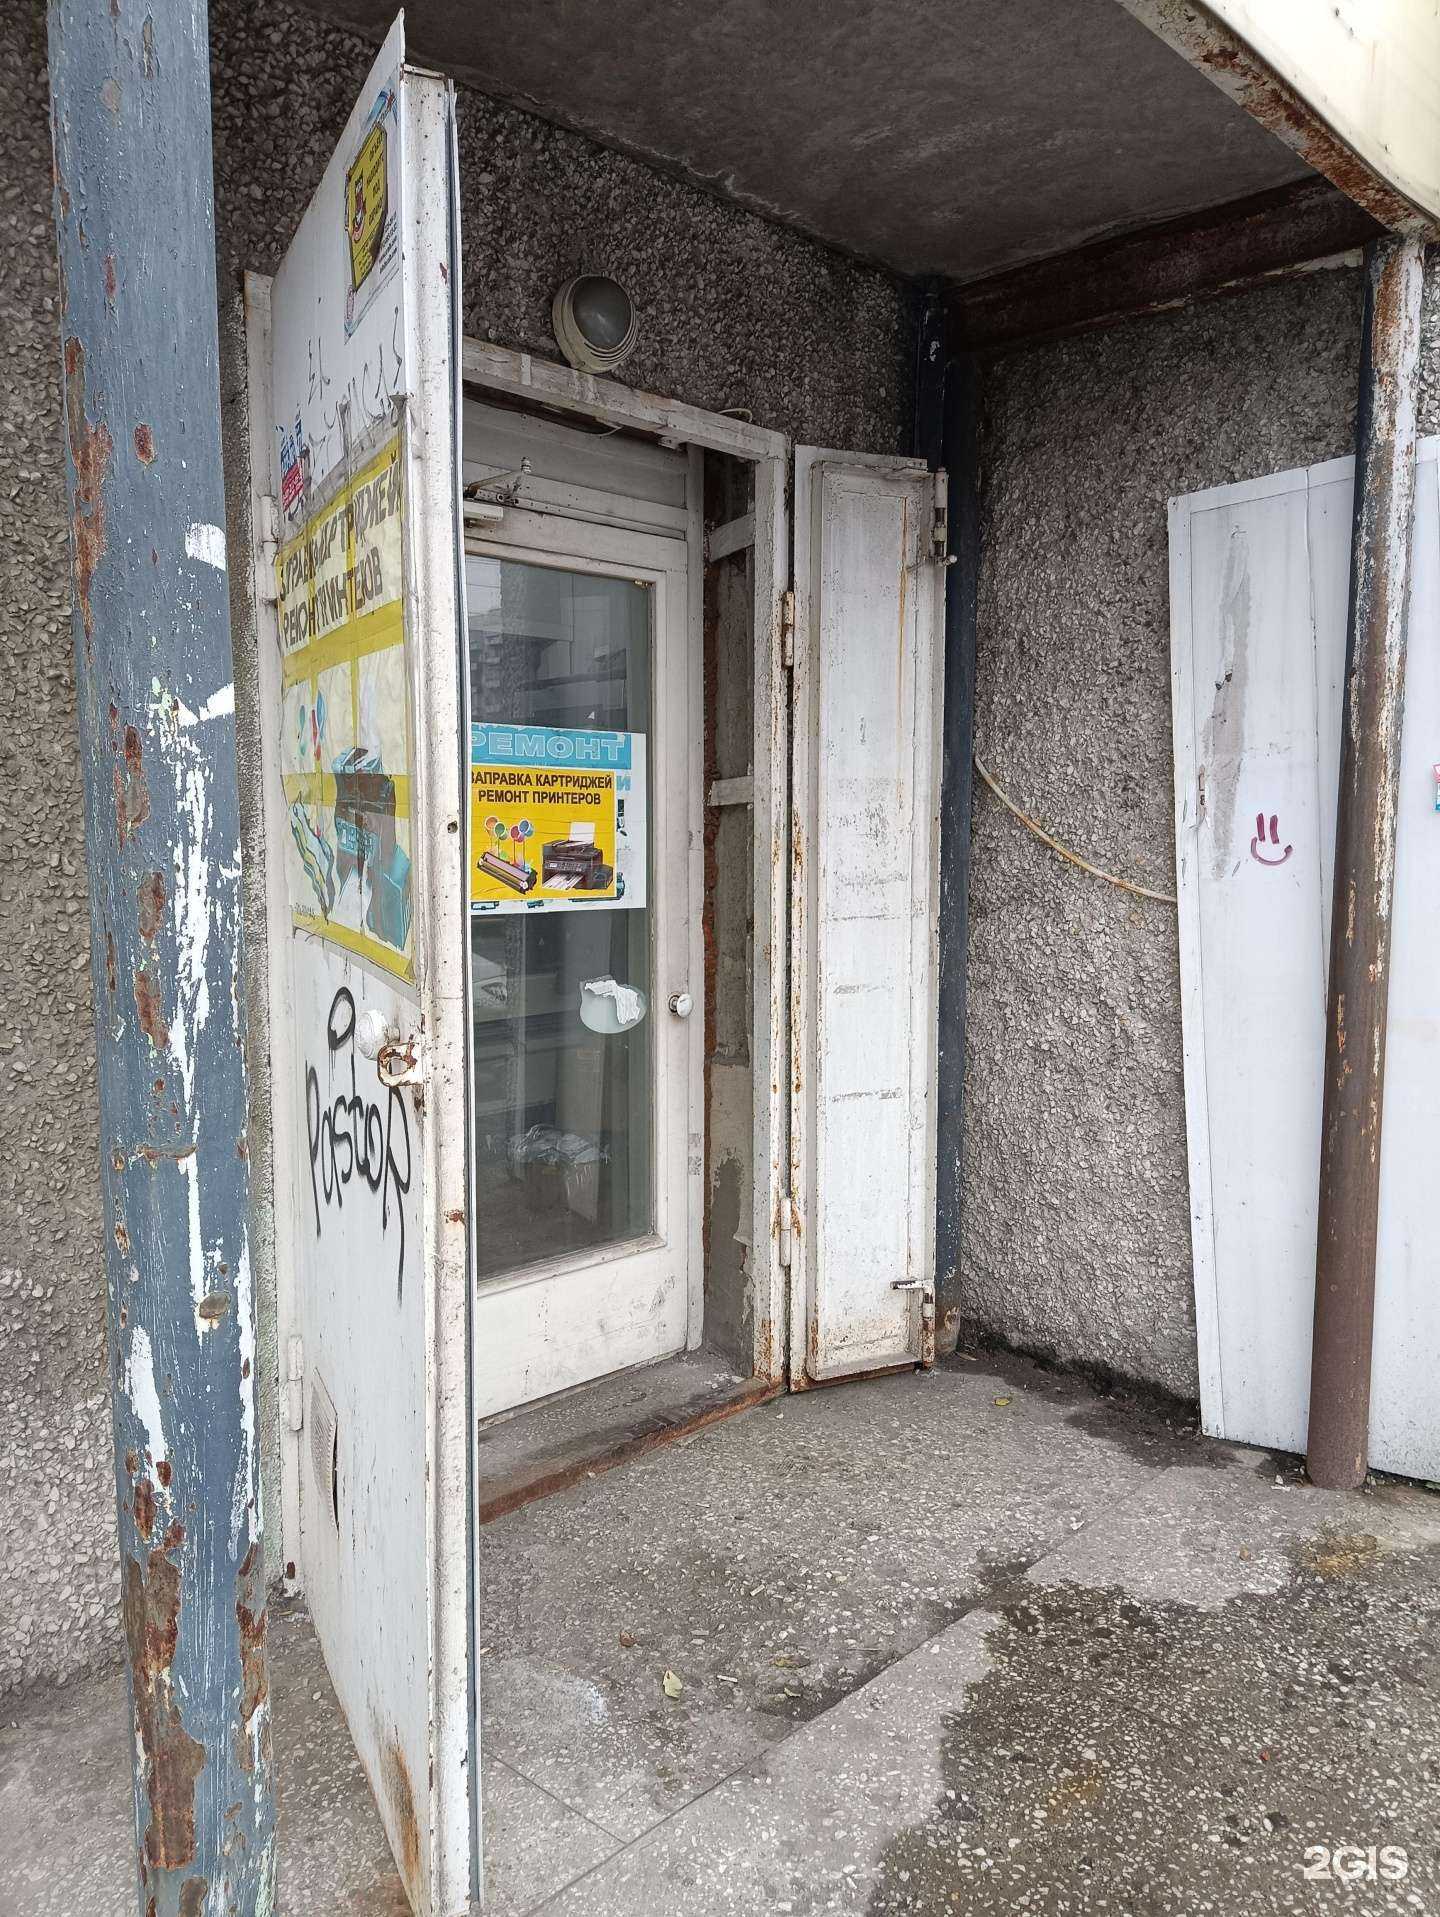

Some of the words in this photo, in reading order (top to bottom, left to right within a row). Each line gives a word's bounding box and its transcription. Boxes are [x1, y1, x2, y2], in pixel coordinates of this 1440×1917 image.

[471, 731, 624, 760] РЕМОНТ
[535, 774, 612, 791] КАРТРИДЖЕЙ
[478, 789, 529, 804] РЕМОНТ
[533, 791, 601, 805] ПРИНТЕРОВ
